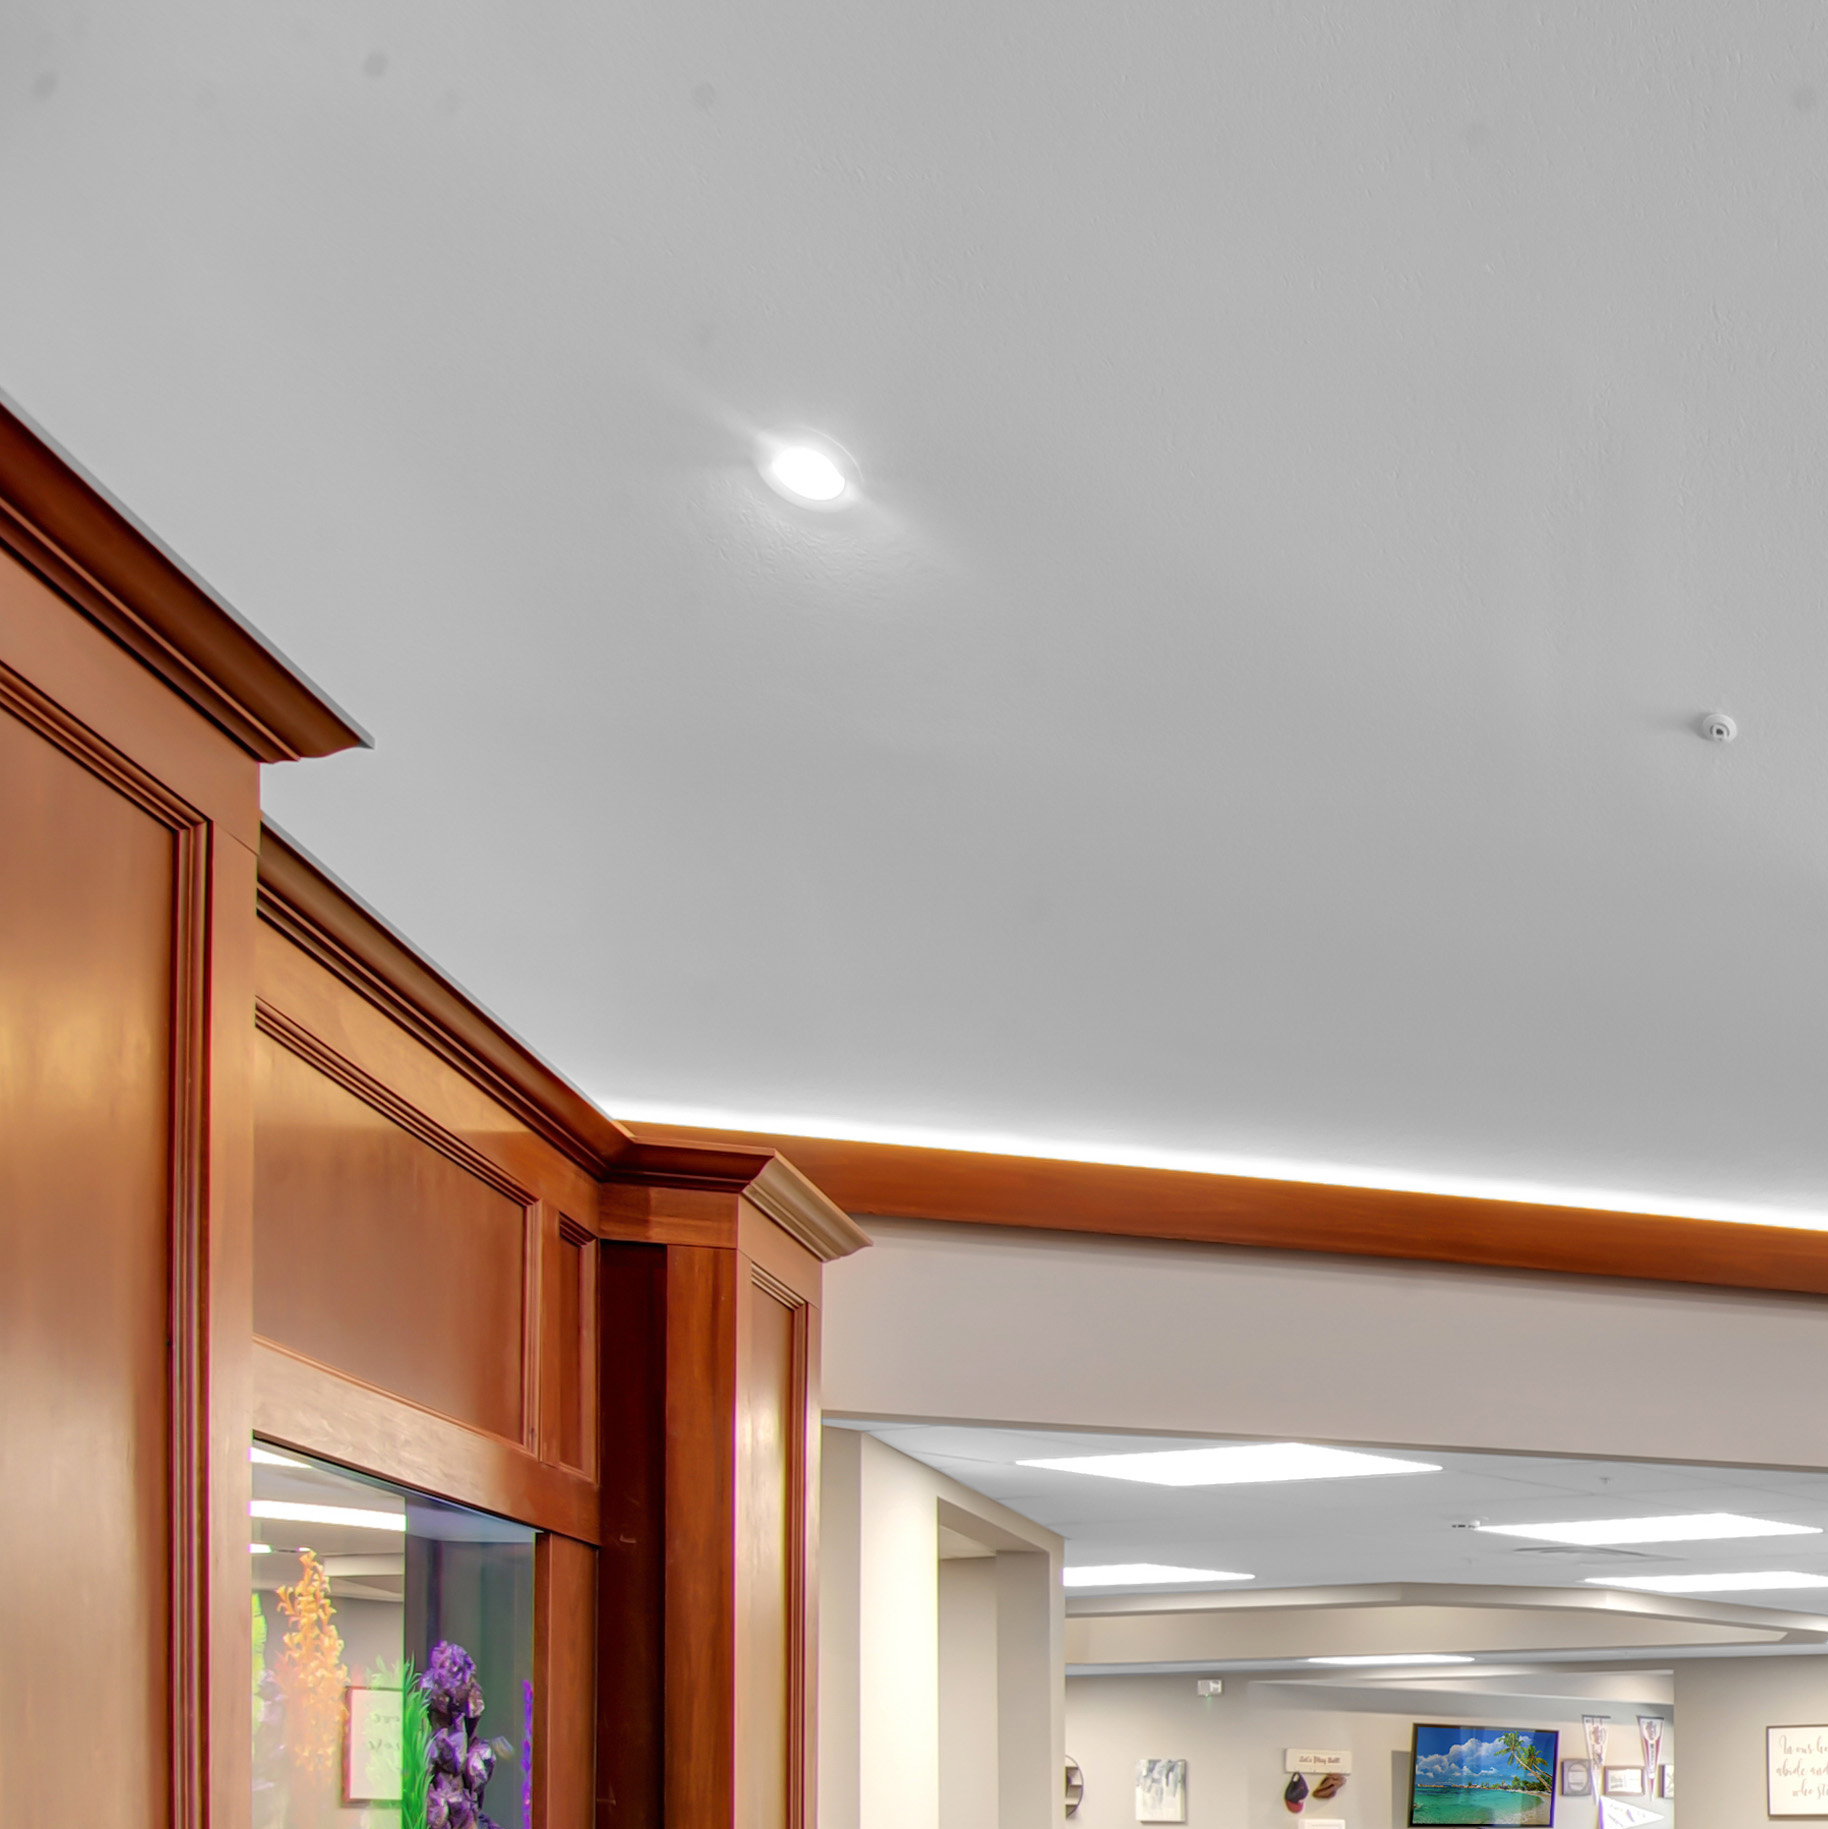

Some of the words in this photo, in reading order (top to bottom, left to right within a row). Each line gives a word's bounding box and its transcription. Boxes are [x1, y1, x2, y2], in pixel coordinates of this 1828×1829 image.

[1796, 1743, 1813, 1754] our
[1776, 1758, 1806, 1777] abide
[1792, 1778, 1813, 1797] who
